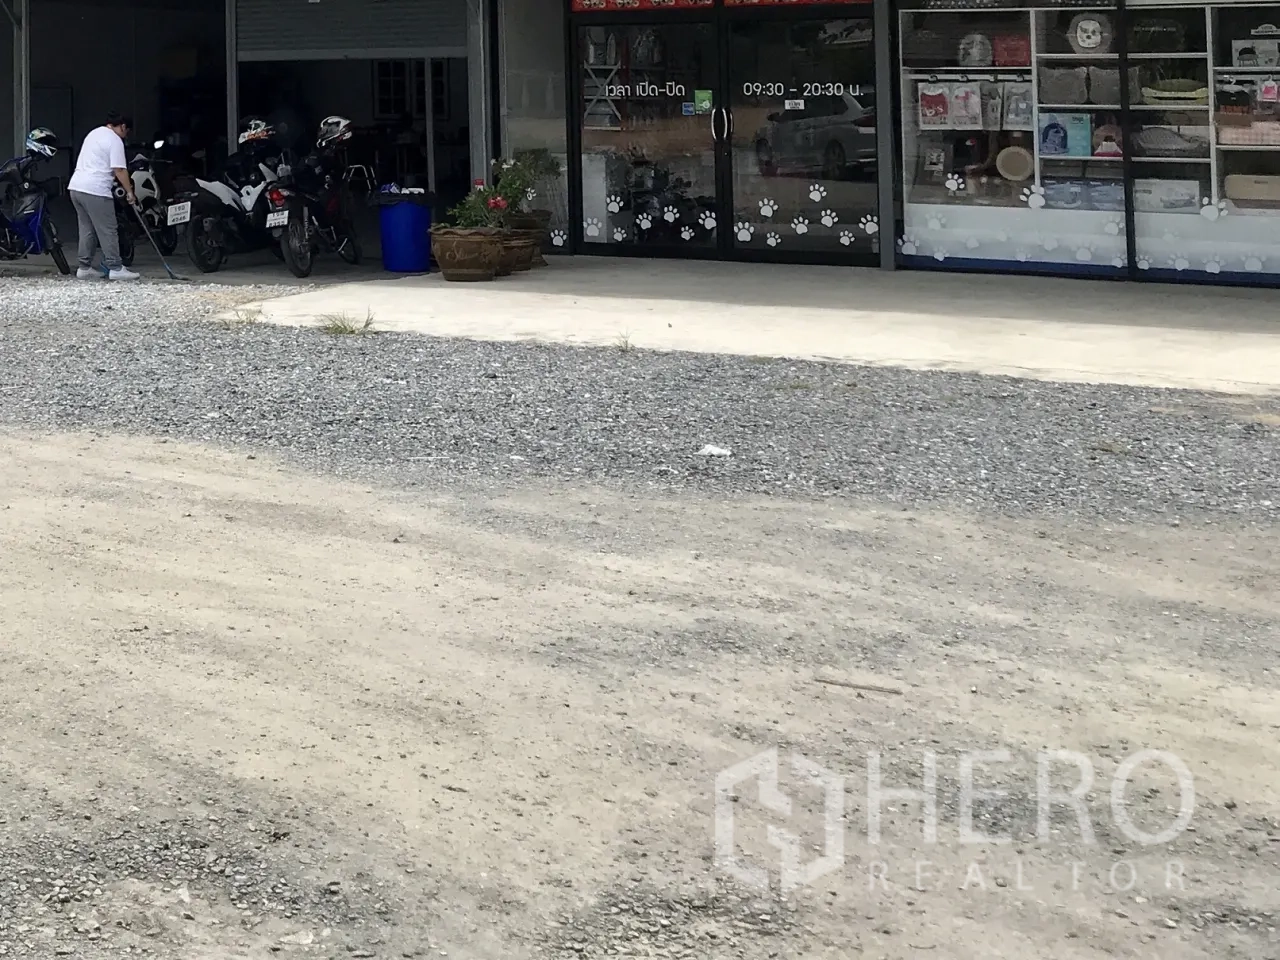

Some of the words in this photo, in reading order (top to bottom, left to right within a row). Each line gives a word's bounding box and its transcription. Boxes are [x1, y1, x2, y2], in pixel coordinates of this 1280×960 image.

[605, 85, 631, 97] เวลา
[636, 81, 686, 97] เปิด-ปิด
[743, 82, 784, 96] 09:30
[802, 82, 844, 96] 20:30
